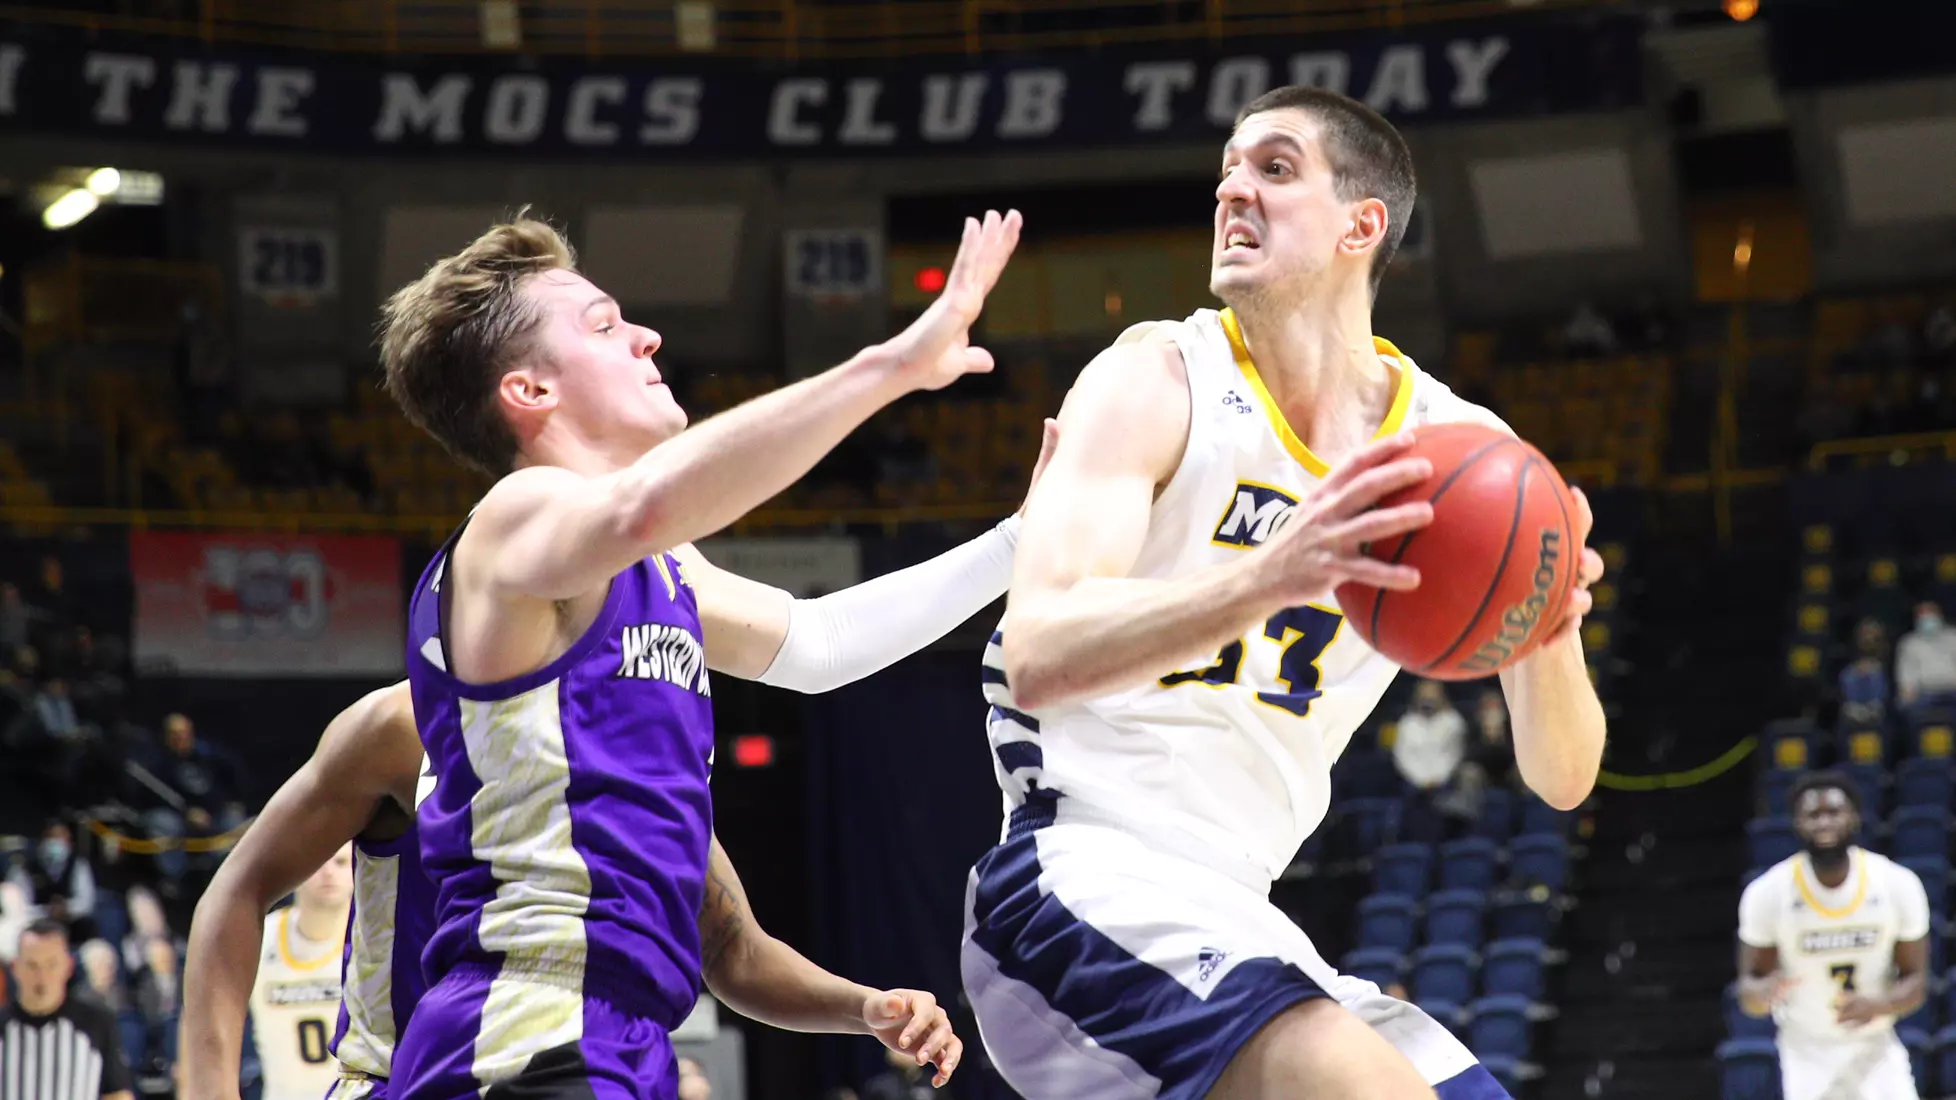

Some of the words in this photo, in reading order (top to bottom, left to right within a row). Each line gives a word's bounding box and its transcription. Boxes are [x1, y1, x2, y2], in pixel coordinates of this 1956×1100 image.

[84, 52, 315, 136] THE
[373, 73, 704, 145] MOCS
[768, 68, 1067, 144] CLUB
[1458, 528, 1560, 670] Wilson
[297, 1018, 329, 1064] 0
